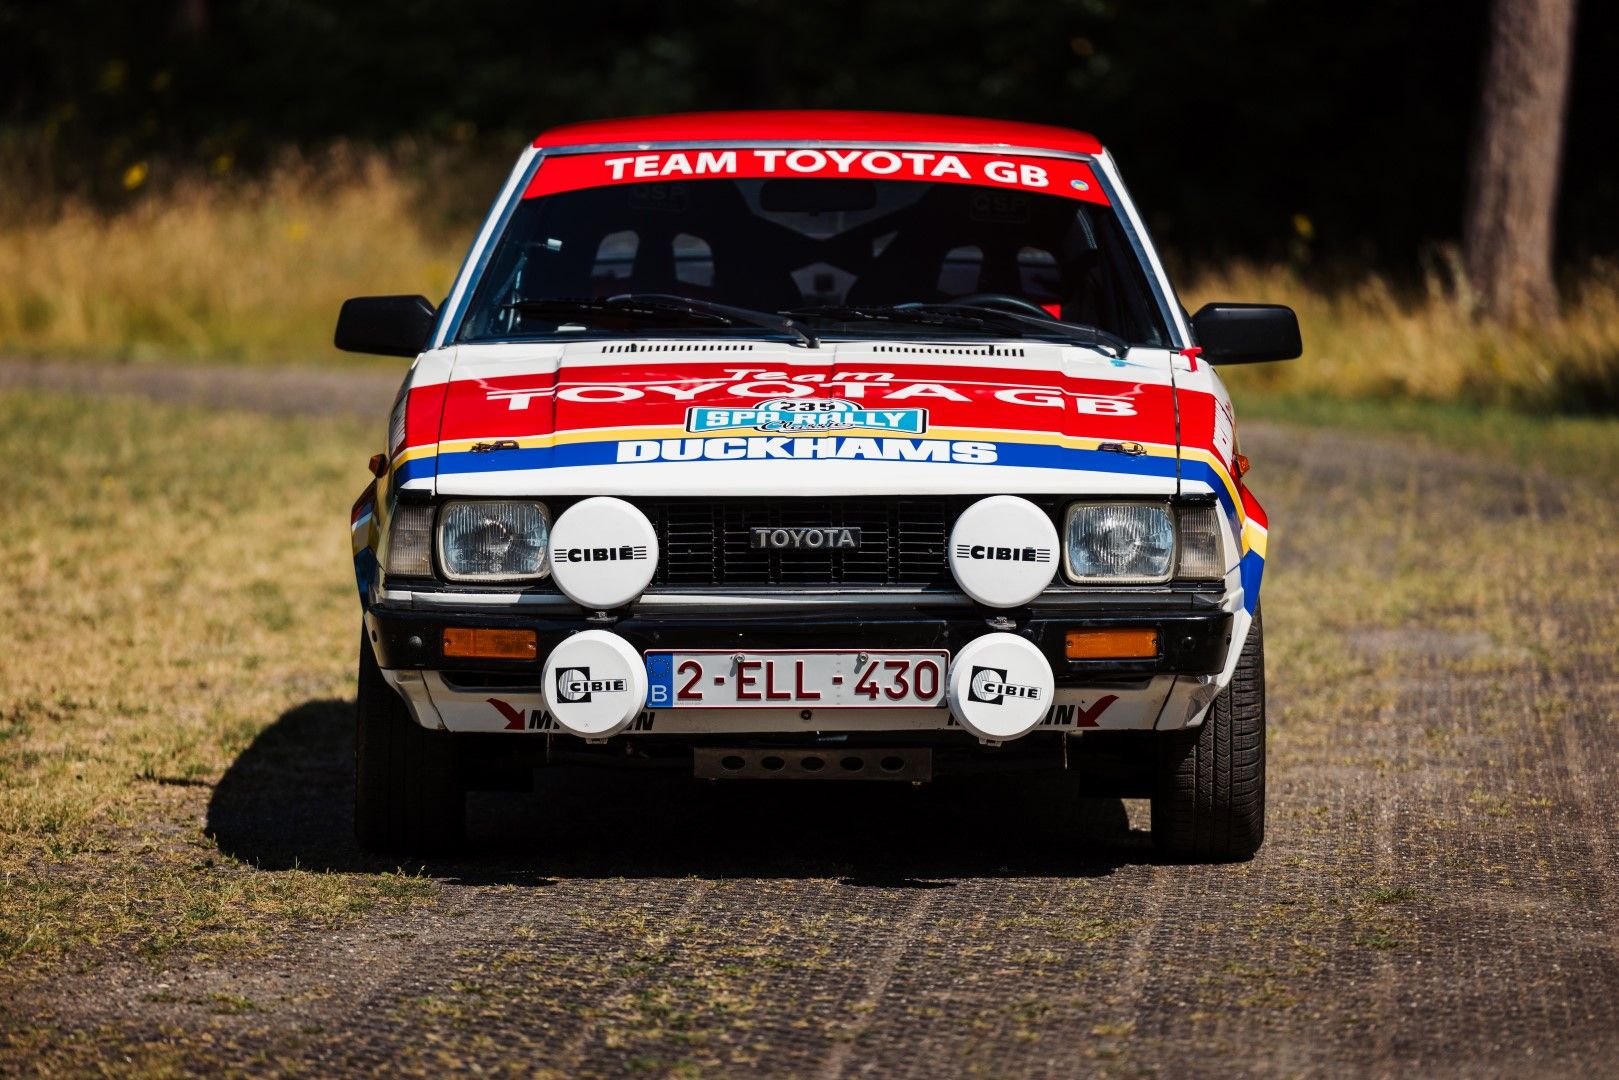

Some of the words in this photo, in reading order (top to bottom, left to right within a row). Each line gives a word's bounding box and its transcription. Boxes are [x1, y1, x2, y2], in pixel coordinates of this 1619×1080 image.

[605, 151, 737, 181] TEAM
[754, 149, 971, 179] TOYOTA
[983, 160, 1050, 188] GB
[723, 368, 895, 382] Team
[486, 380, 973, 411] TOYOTA
[993, 388, 1139, 417] GB
[780, 401, 836, 412] 235
[706, 411, 780, 428] SPA
[794, 411, 908, 428] RALLY
[616, 436, 998, 464] DUCKHAMS
[755, 527, 856, 549] TOYOTA
[651, 684, 668, 702] B
